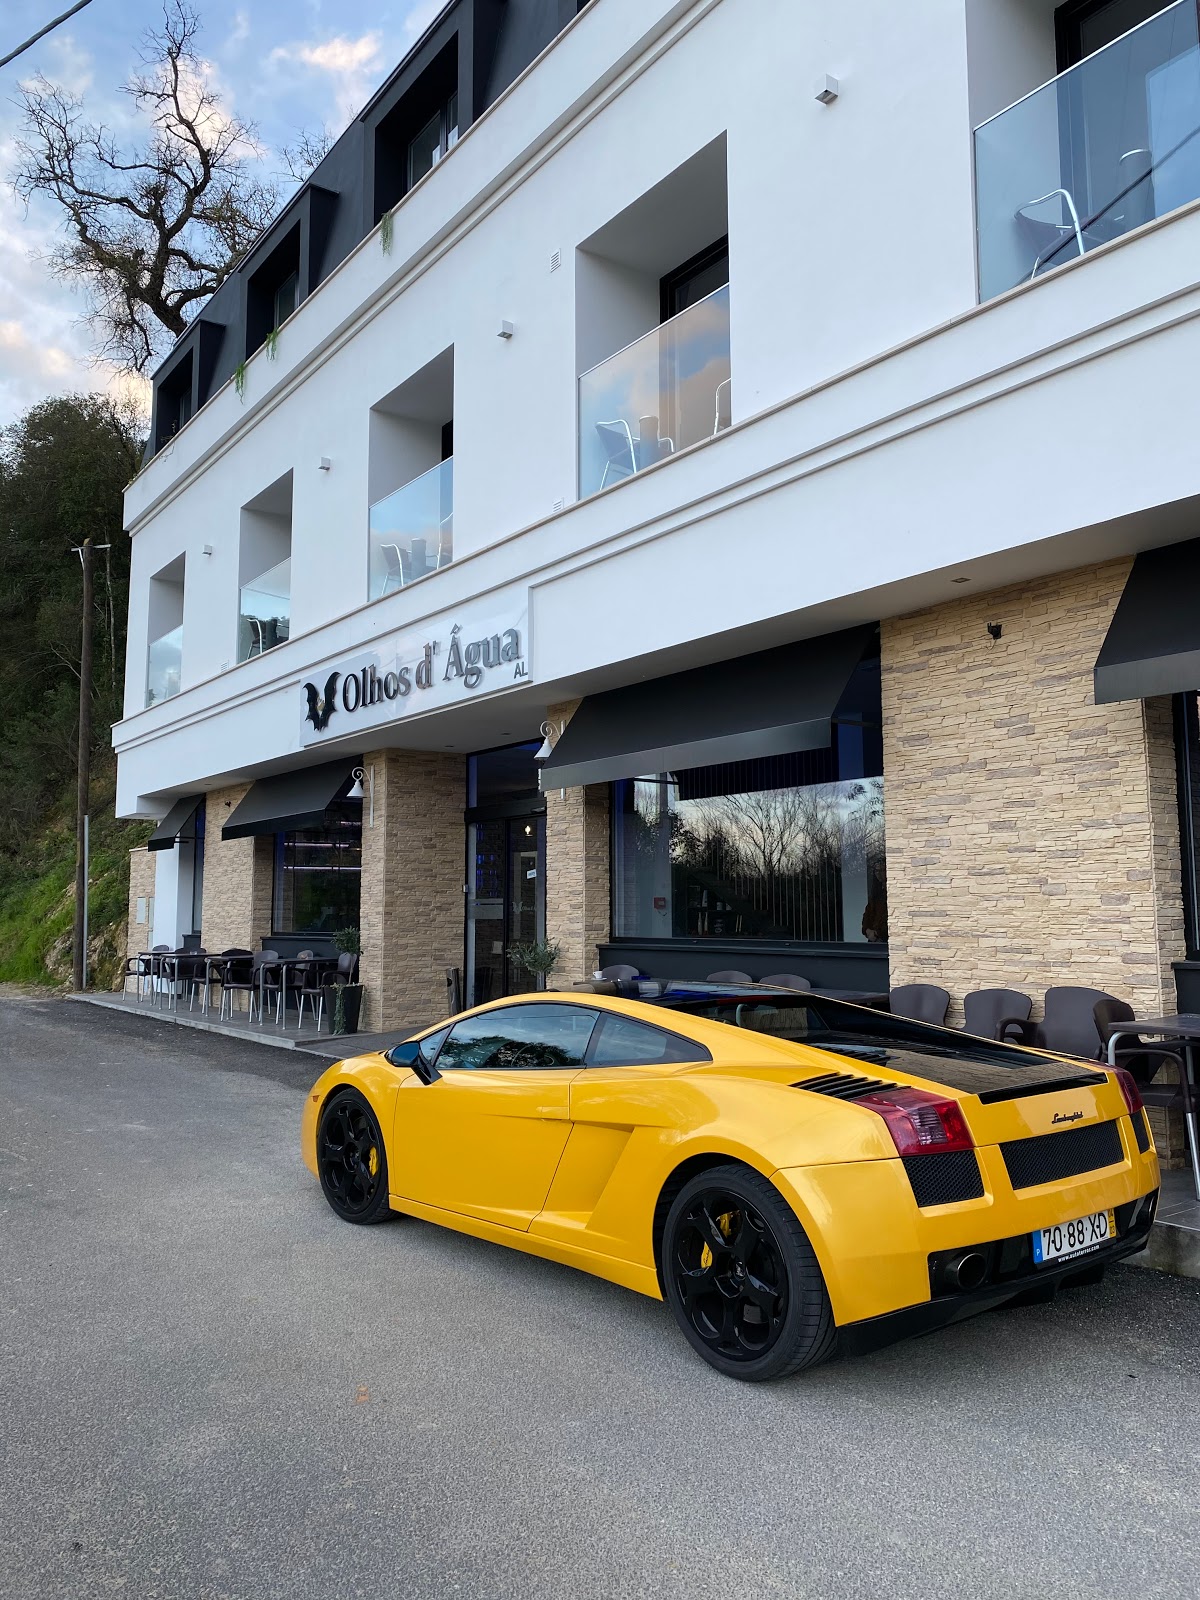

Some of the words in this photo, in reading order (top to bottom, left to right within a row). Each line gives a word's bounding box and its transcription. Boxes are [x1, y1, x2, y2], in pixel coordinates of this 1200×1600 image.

[342, 663, 411, 713] Olhos
[443, 623, 523, 689] Água
[514, 661, 528, 679] AL
[1036, 1248, 1041, 1257] P
